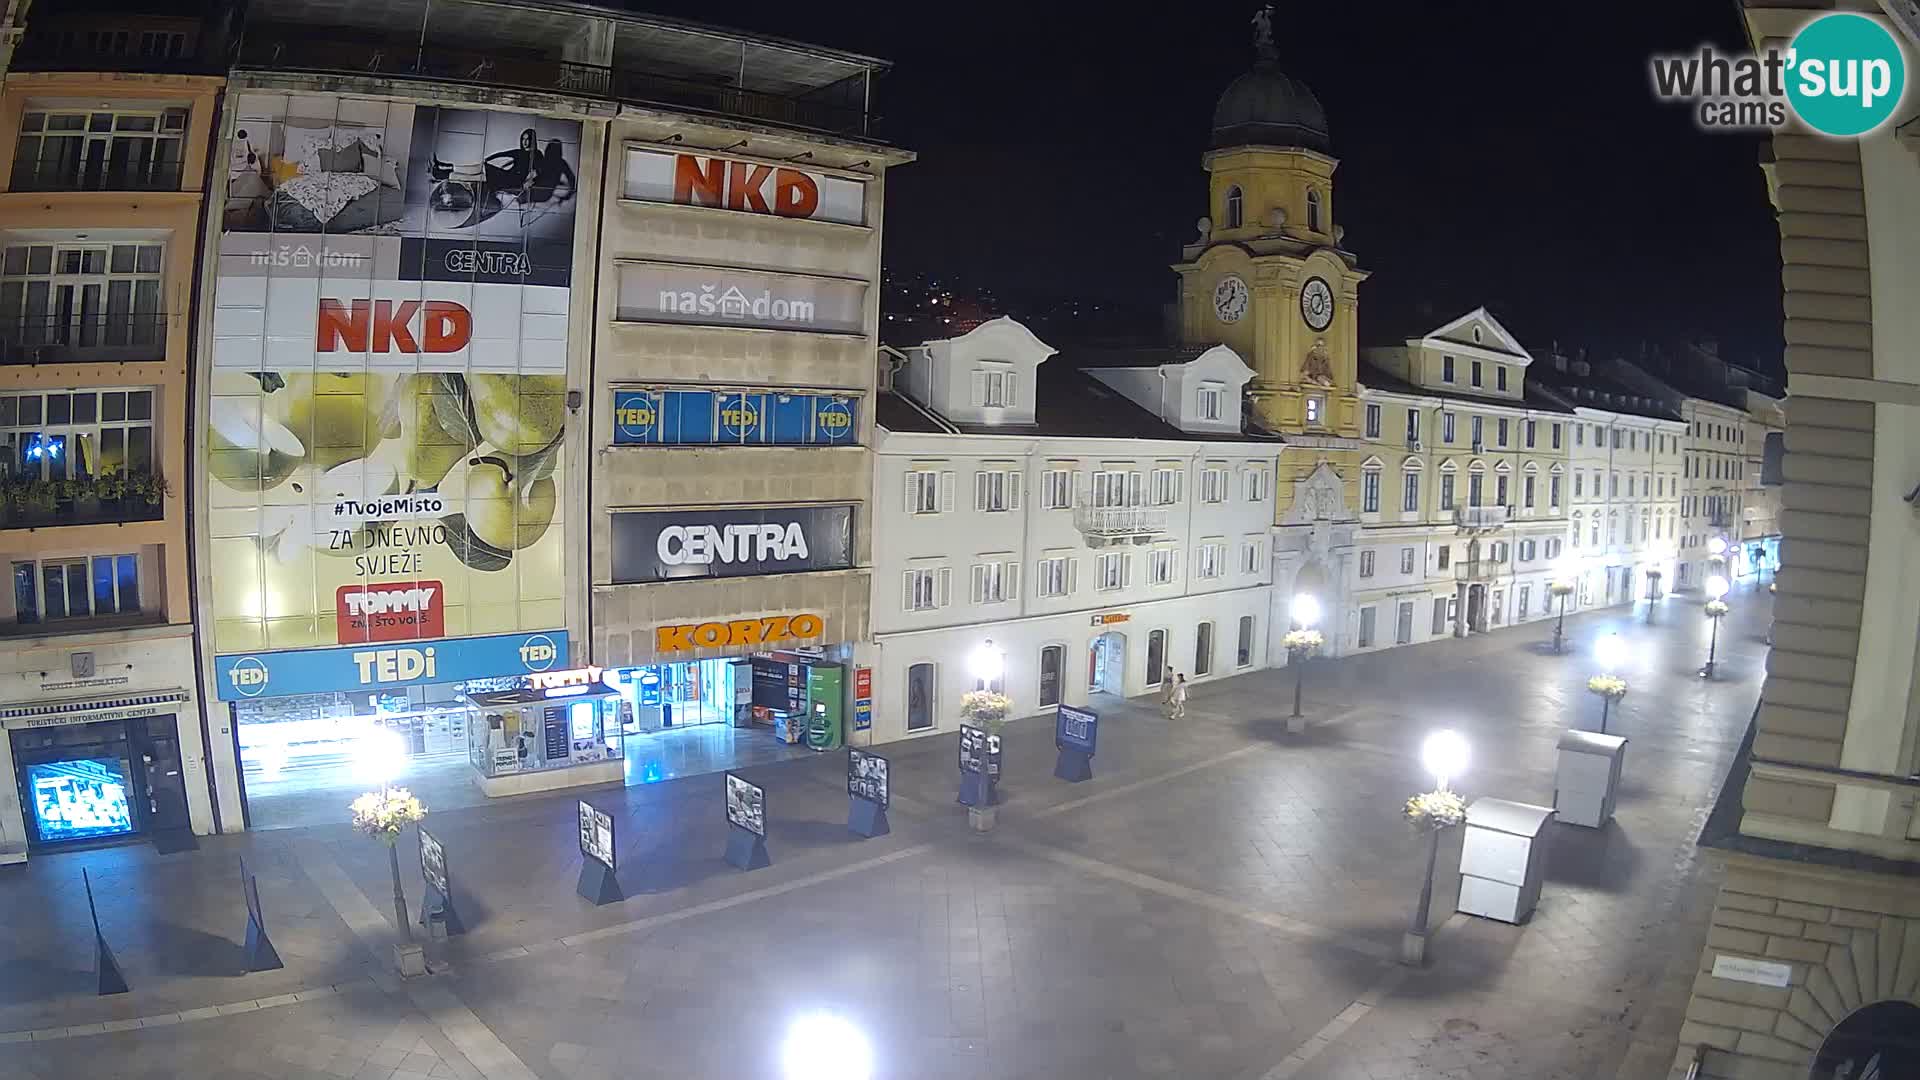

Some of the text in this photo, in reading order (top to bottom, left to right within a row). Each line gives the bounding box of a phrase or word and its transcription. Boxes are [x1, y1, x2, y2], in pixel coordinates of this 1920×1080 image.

[673, 153, 819, 218] NKD
[250, 246, 361, 268] naš dom
[444, 249, 532, 275] CENTRA
[659, 284, 815, 322] naš dom
[316, 298, 473, 353] NKD
[616, 408, 656, 425] TEDi
[721, 409, 758, 427] TEDi
[818, 411, 851, 427] TEDi
[333, 498, 443, 518] #TvojeMisto
[329, 524, 447, 550] ZA DNEVNO
[656, 522, 809, 566] CENTRA
[355, 550, 423, 577] SVJEŽE
[344, 587, 435, 616] TOMMY
[375, 614, 396, 627] ŠTO
[656, 613, 824, 652] KORZO
[353, 648, 436, 684] TEDi
[519, 646, 557, 664] TEDi
[229, 666, 269, 686] TEDi
